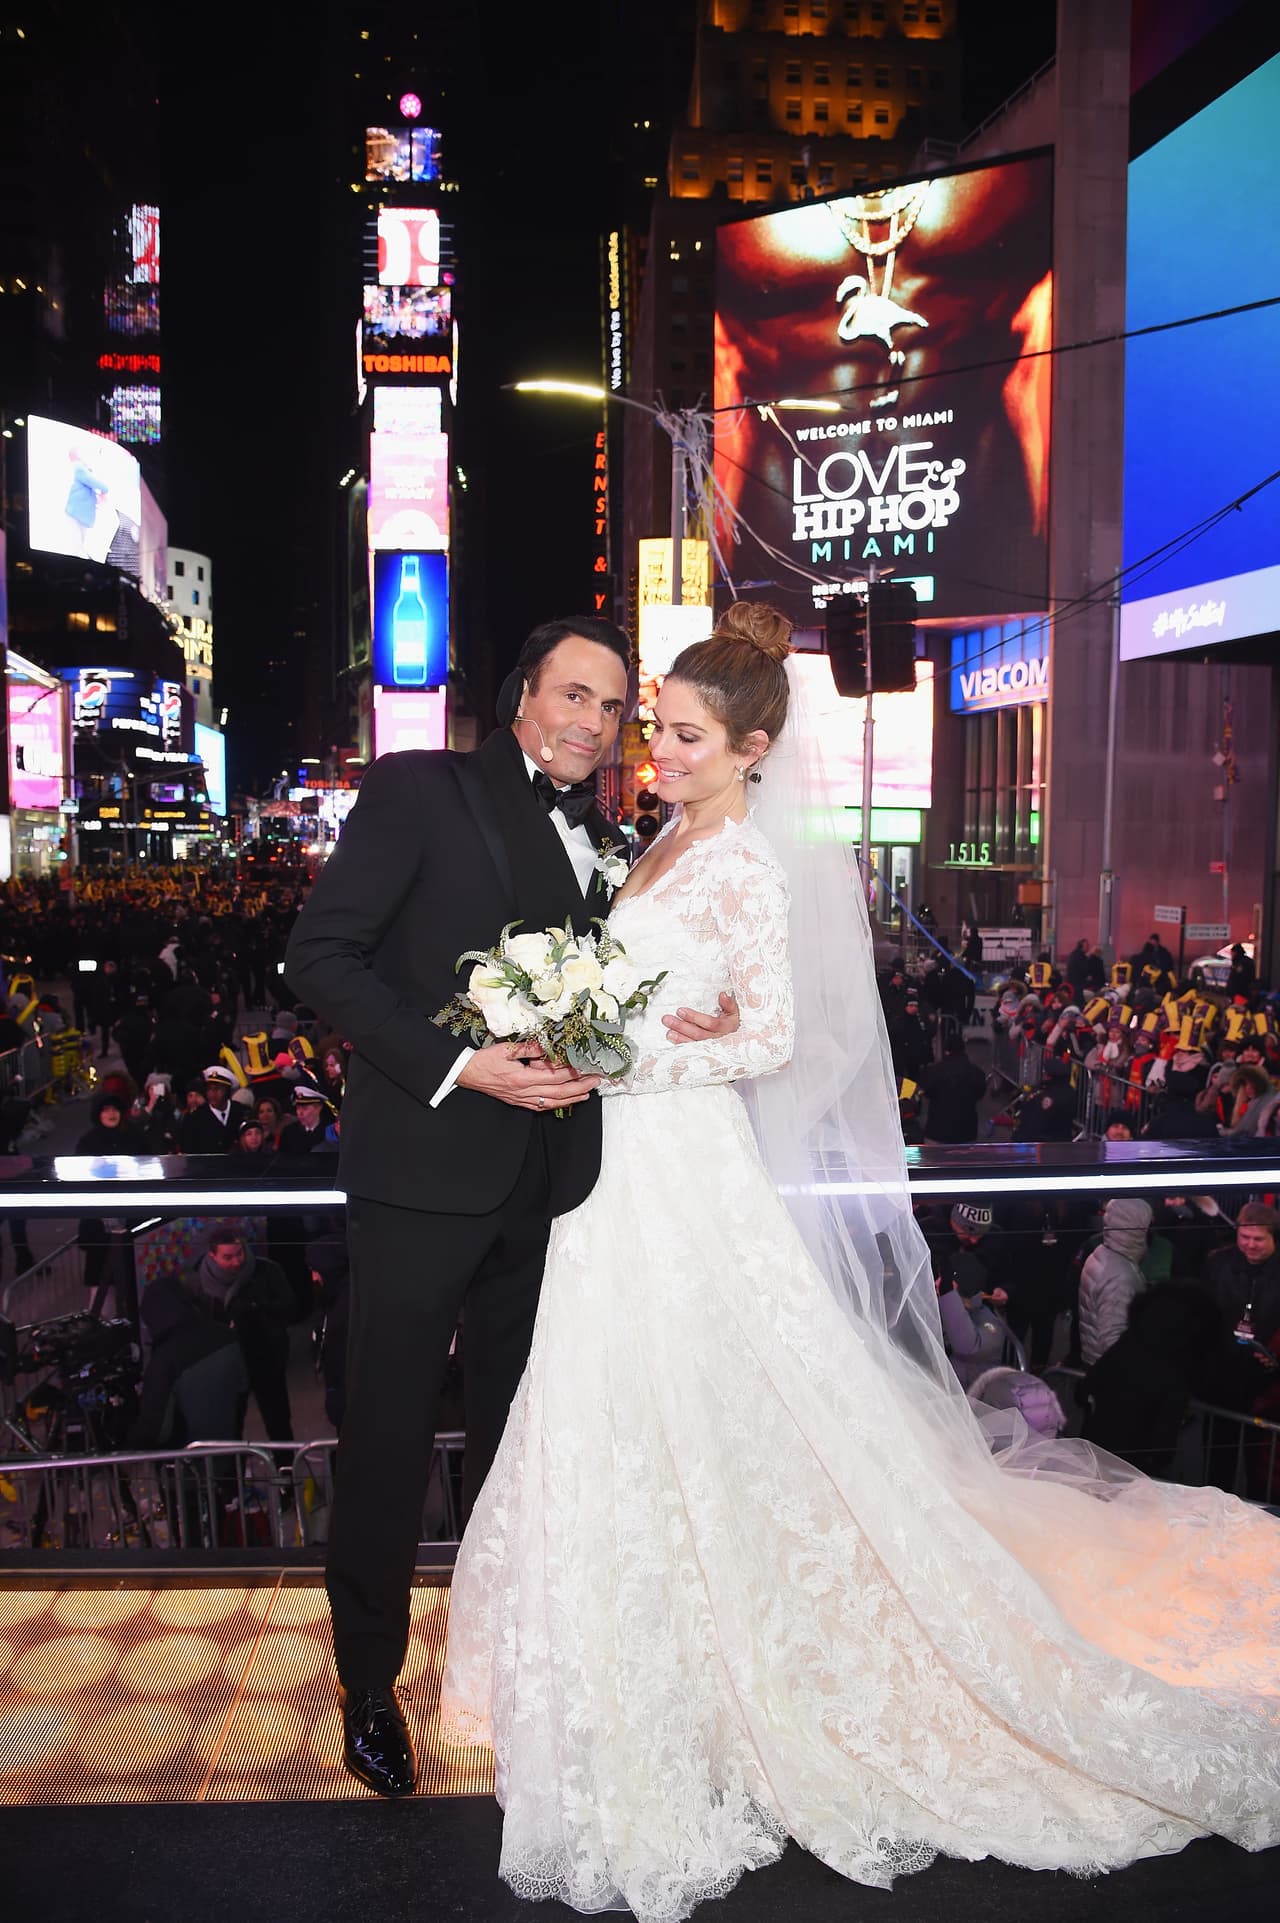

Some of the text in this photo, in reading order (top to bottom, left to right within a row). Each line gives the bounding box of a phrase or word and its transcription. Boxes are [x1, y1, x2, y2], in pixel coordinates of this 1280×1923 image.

[363, 354, 451, 374] TOSHIBA
[796, 409, 954, 442] WELCOME TO MIAMI
[593, 432, 608, 535] ERNST
[793, 441, 966, 504] LOVE &
[792, 490, 960, 541] HIP HOP
[811, 531, 934, 563] MIAMI
[594, 556, 608, 572] &
[949, 842, 990, 863] 1515
[957, 1203, 990, 1222] TRIO
